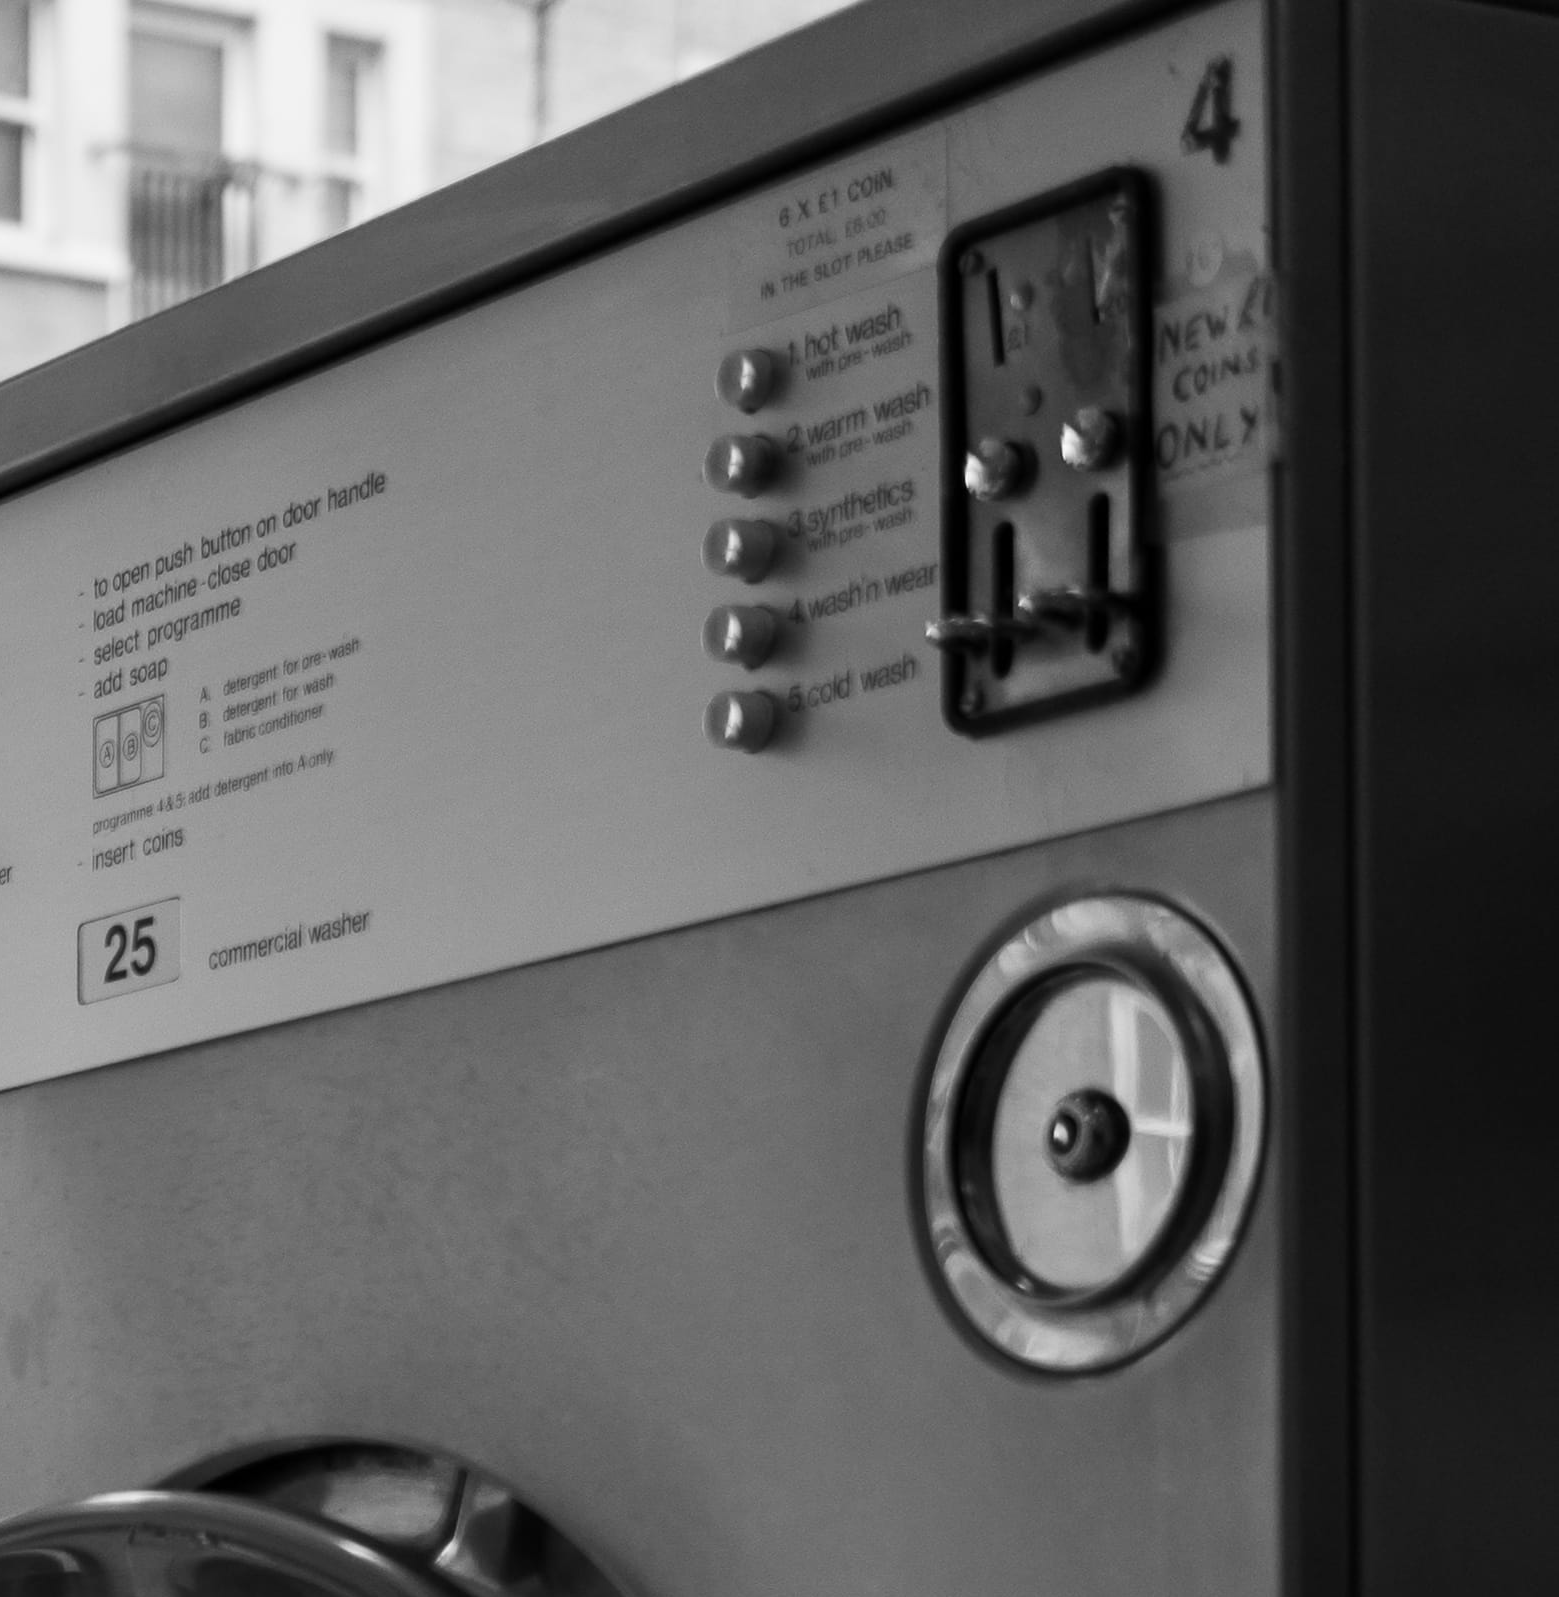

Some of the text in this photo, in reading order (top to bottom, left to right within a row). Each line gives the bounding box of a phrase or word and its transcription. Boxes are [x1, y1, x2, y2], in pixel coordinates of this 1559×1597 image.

[1182, 54, 1241, 166] 4
[797, 200, 810, 222] X
[847, 168, 893, 202] COIN
[760, 233, 913, 300] IN THE SLOT PLEASE
[844, 303, 901, 345] wash
[1159, 306, 1230, 365] NEW
[805, 359, 834, 381] with
[1171, 346, 1259, 403] COINS
[873, 381, 931, 423] wash
[806, 444, 835, 466] with
[1154, 402, 1258, 470] ONLY
[93, 471, 387, 600] to open push button on door handle
[806, 531, 835, 552] with
[93, 603, 125, 633] load
[257, 540, 297, 573] door
[884, 563, 938, 597] wear
[93, 597, 242, 666] select programme
[93, 655, 168, 699] add soap
[222, 664, 278, 697] detergent
[283, 657, 300, 677] for
[222, 690, 278, 723] detergent
[282, 684, 299, 703] for
[302, 672, 335, 698] wash
[860, 653, 917, 693] wash
[223, 723, 256, 748] fabric
[258, 703, 324, 740] conditioner
[92, 802, 154, 836] programme
[188, 785, 211, 805] add
[213, 765, 269, 797] detergent
[296, 753, 307, 772] A
[307, 748, 334, 770] only
[92, 827, 184, 873] insert coins
[103, 915, 157, 985] 25
[208, 909, 371, 970] commercial washer
